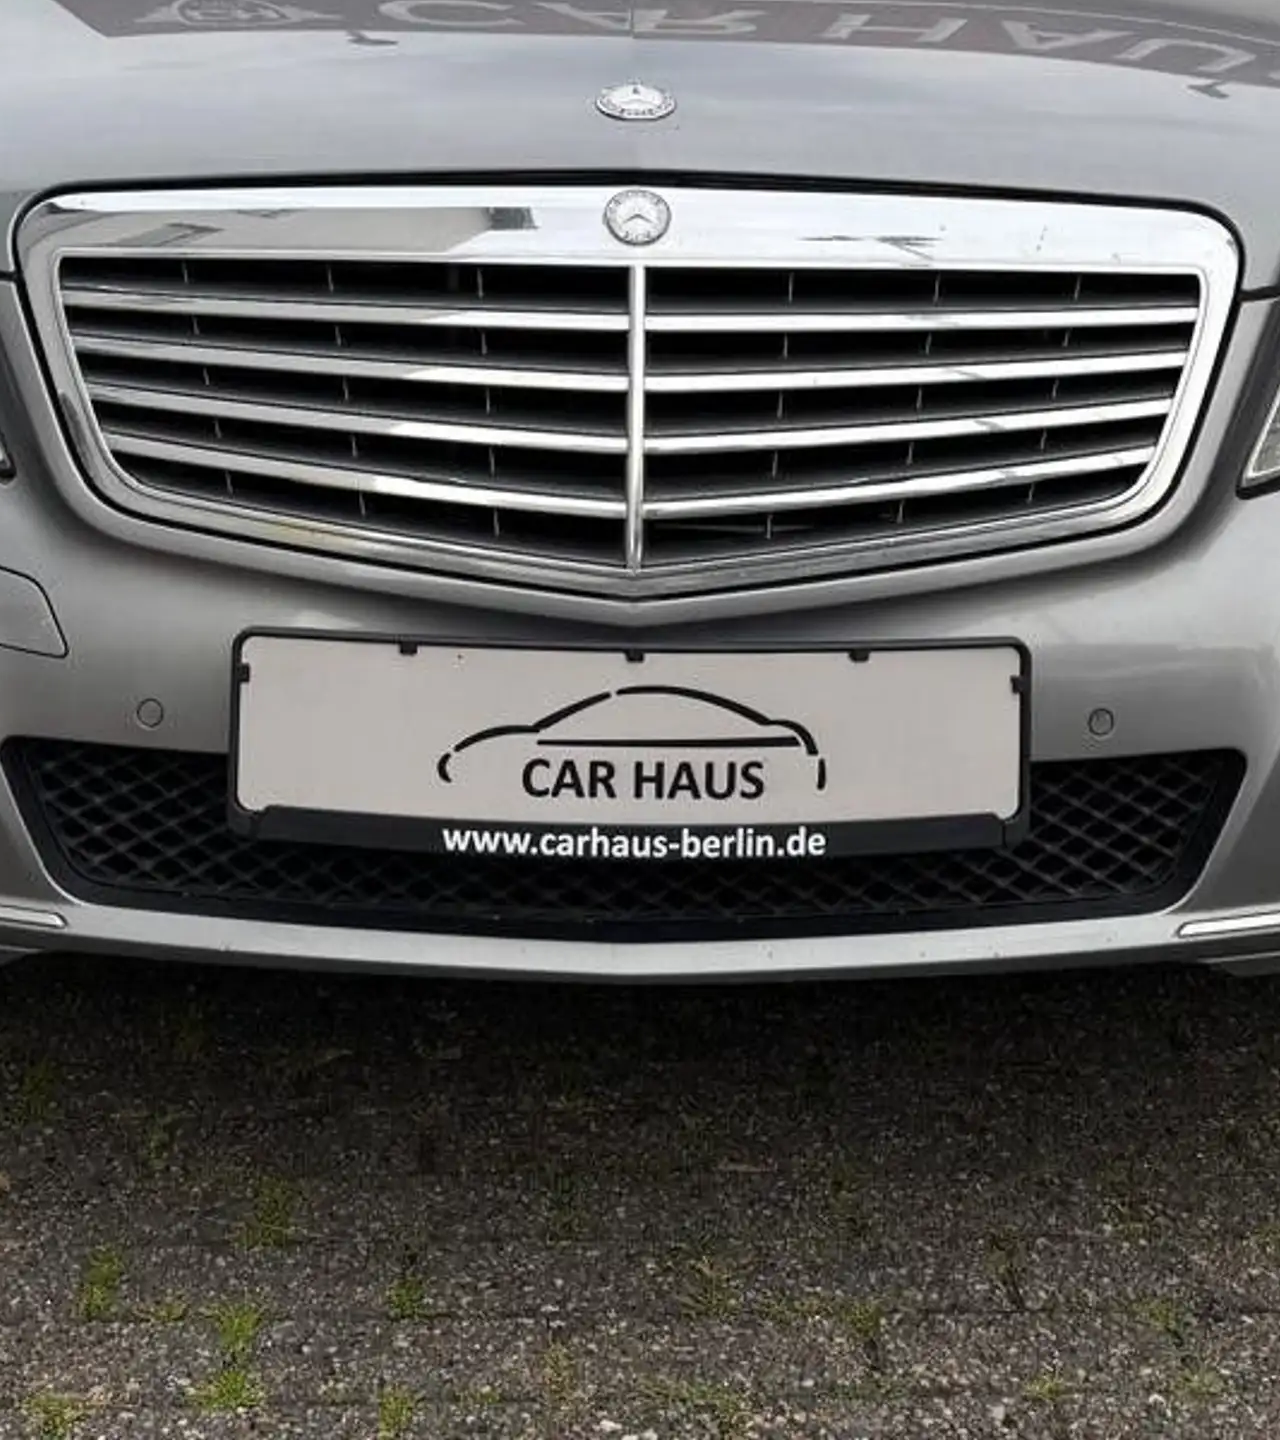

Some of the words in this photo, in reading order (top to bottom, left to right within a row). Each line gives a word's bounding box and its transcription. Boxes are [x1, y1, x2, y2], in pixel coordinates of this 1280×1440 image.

[522, 758, 616, 798] CAR
[632, 760, 765, 800] HAUS
[442, 826, 827, 859] www.carhaus-berlin.de
